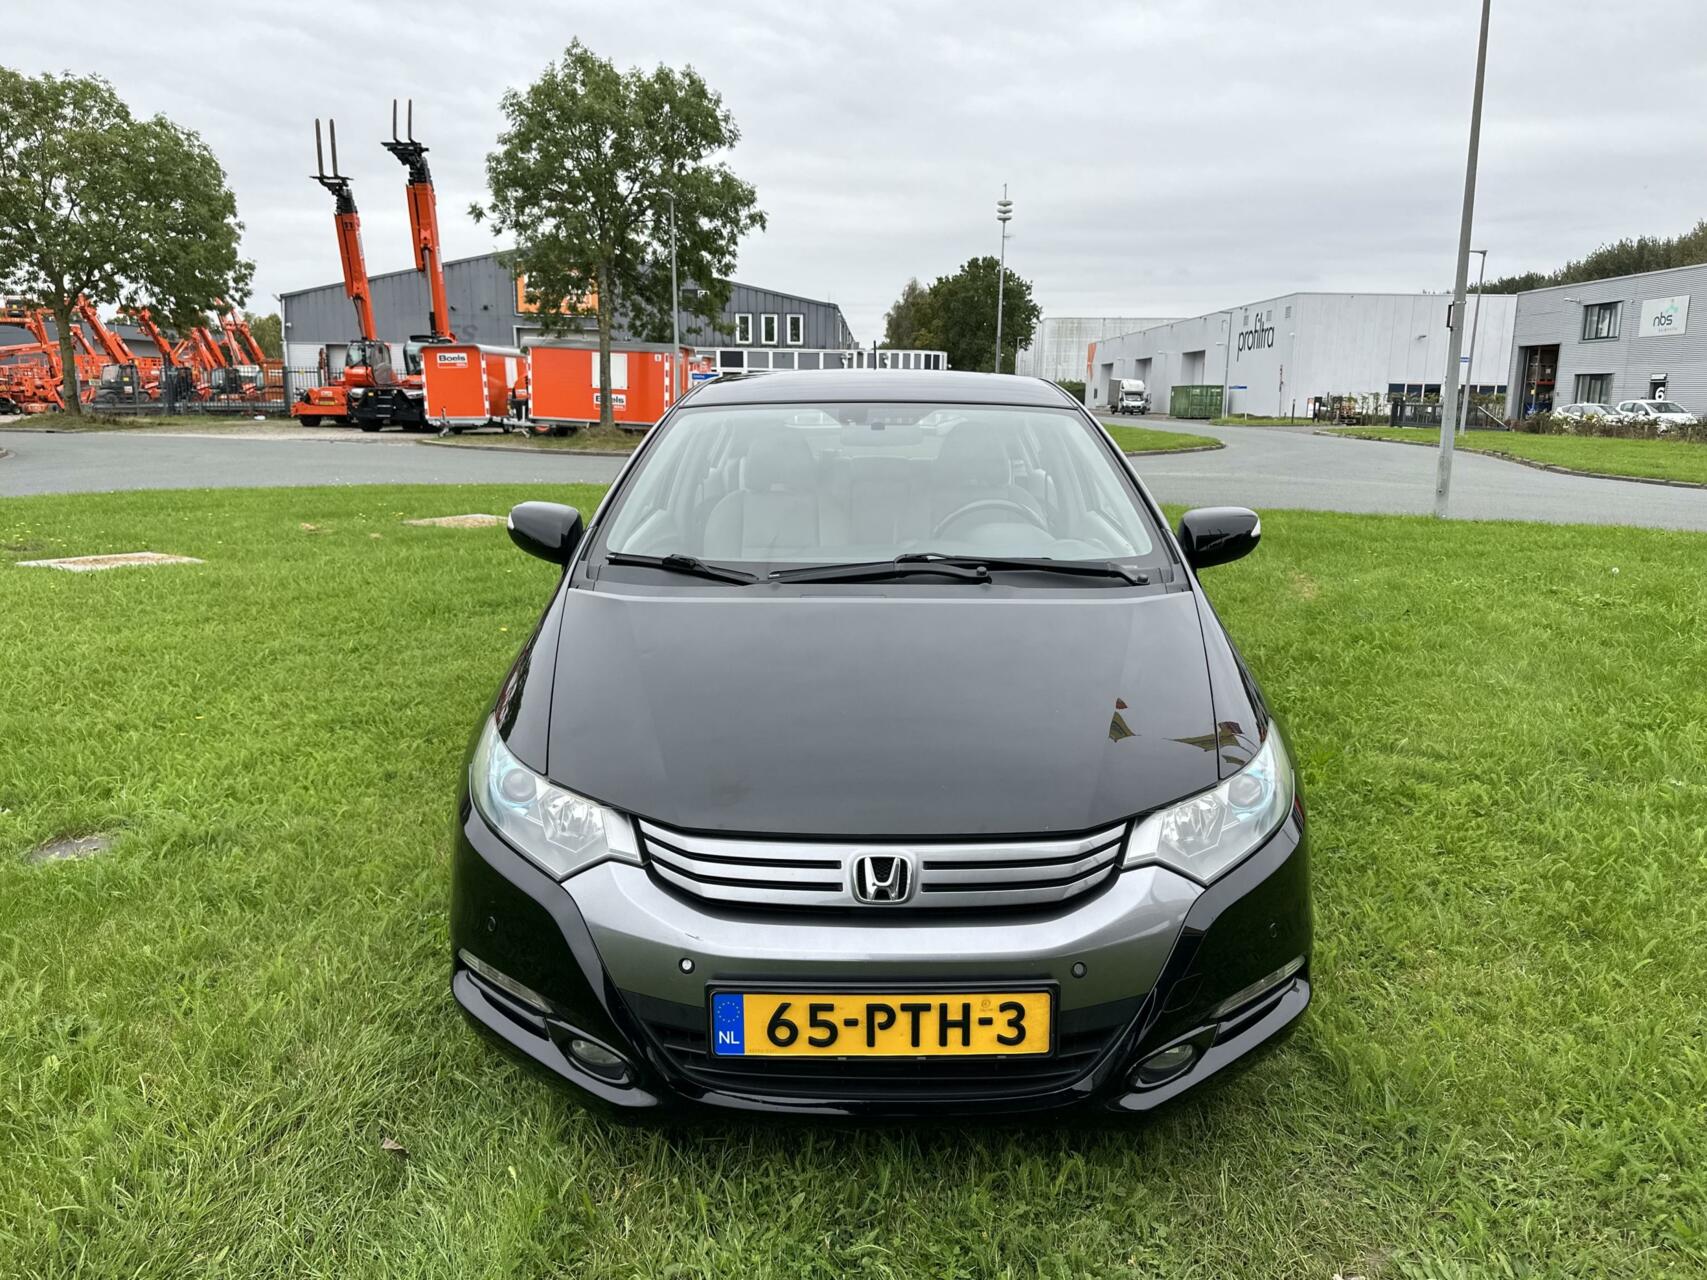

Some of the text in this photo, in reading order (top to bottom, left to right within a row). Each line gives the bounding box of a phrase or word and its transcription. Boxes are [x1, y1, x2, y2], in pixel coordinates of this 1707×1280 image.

[1653, 311, 1673, 326] nbs
[1236, 312, 1274, 362] profiltra
[719, 1030, 740, 1044] NL
[766, 1001, 1026, 1047] 65-PTH-3
